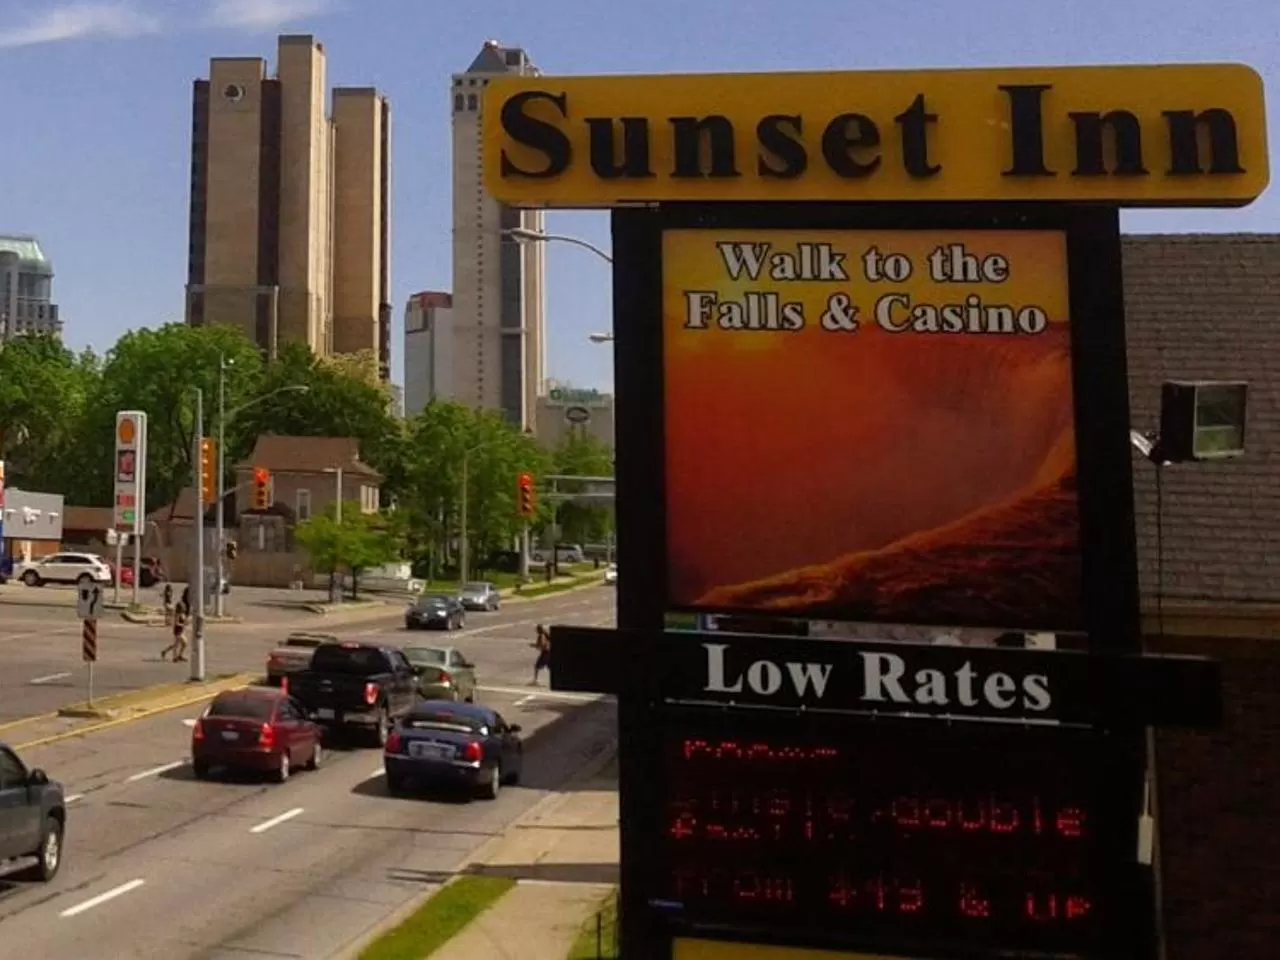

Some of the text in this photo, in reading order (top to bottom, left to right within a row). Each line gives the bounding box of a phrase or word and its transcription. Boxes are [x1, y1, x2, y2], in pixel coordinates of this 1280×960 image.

[500, 83, 1246, 179] Sunset Inn
[717, 241, 1009, 282] Walk to the
[685, 291, 1048, 333] Falls & Casino
[702, 643, 1051, 711] Low Rates
